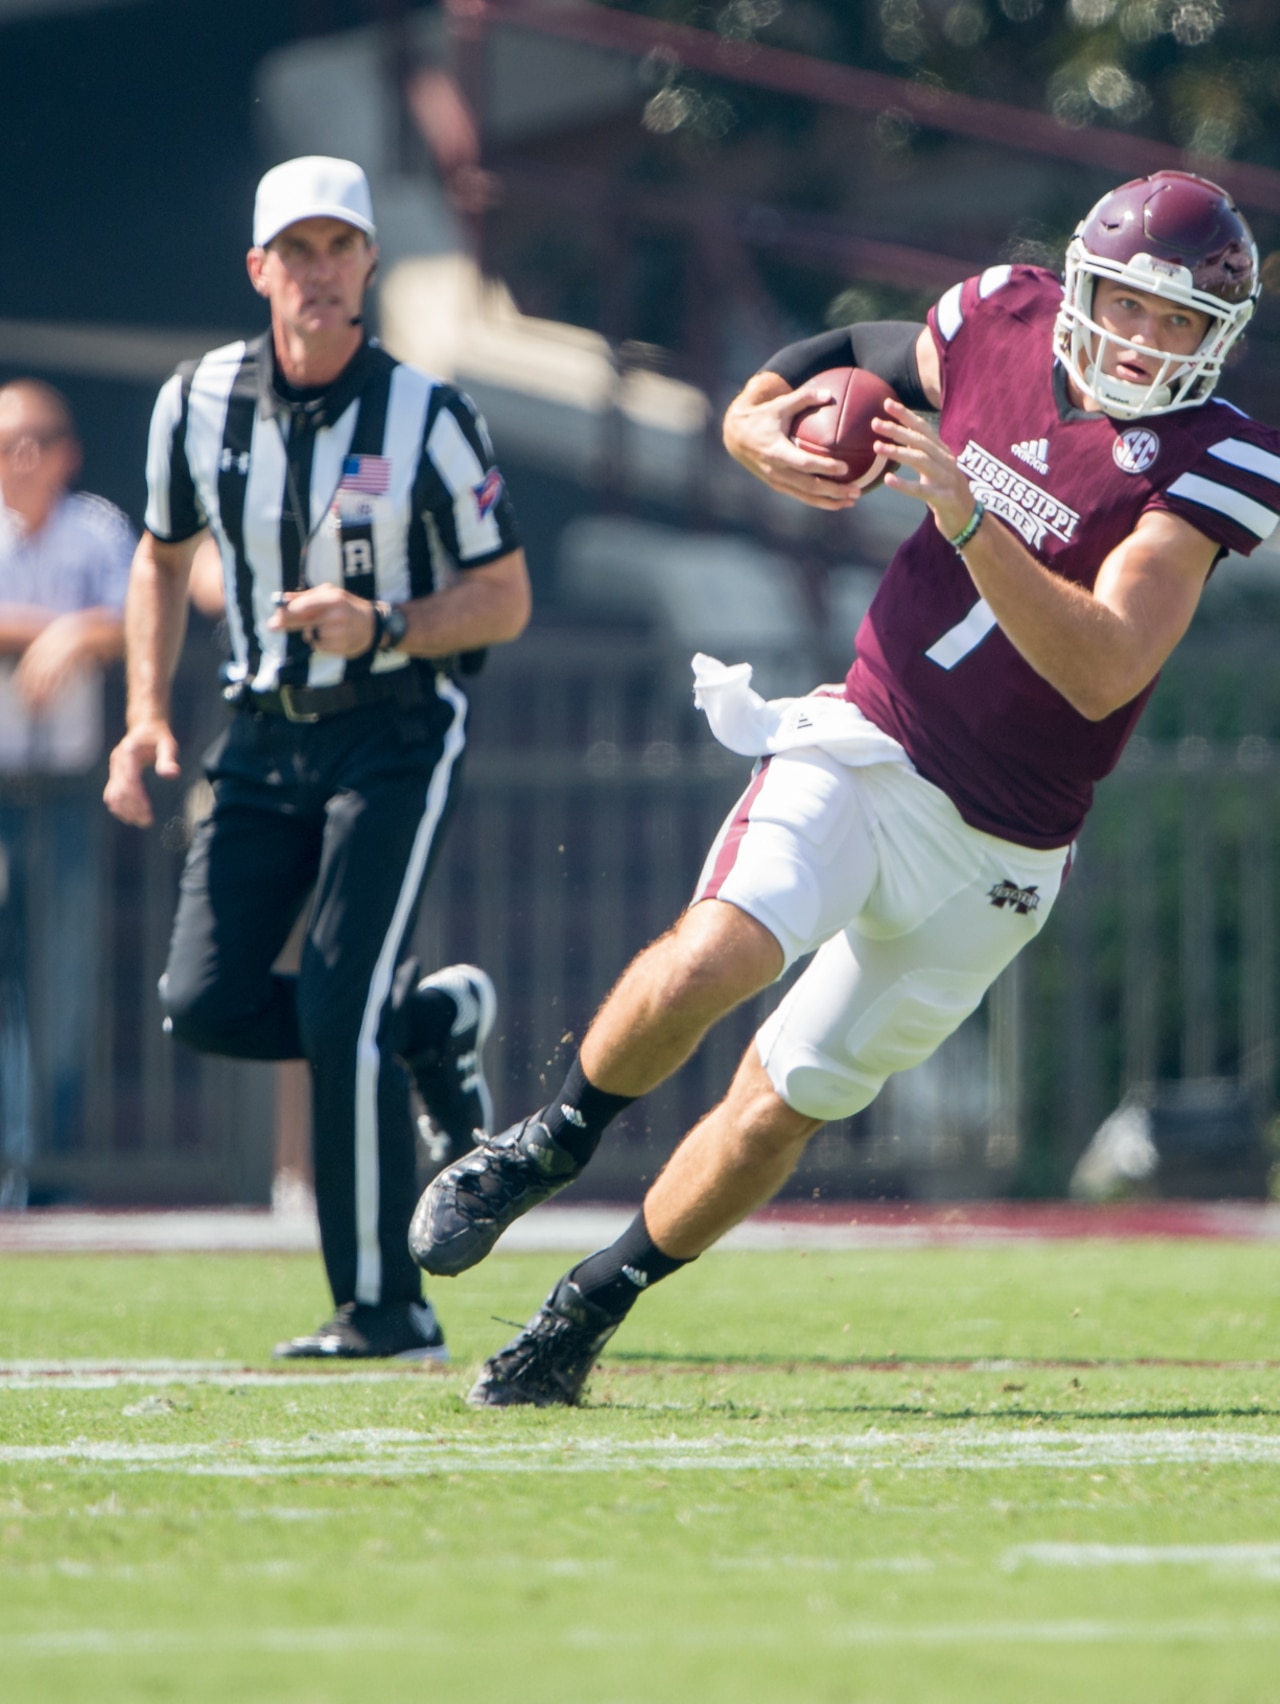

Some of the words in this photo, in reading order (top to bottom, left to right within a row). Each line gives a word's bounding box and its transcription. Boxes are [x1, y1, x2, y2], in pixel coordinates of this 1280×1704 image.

[1114, 430, 1157, 470] SEC
[957, 443, 1079, 538] MISSISSIPPI
[980, 491, 1033, 535] STATE
[343, 539, 374, 578] R
